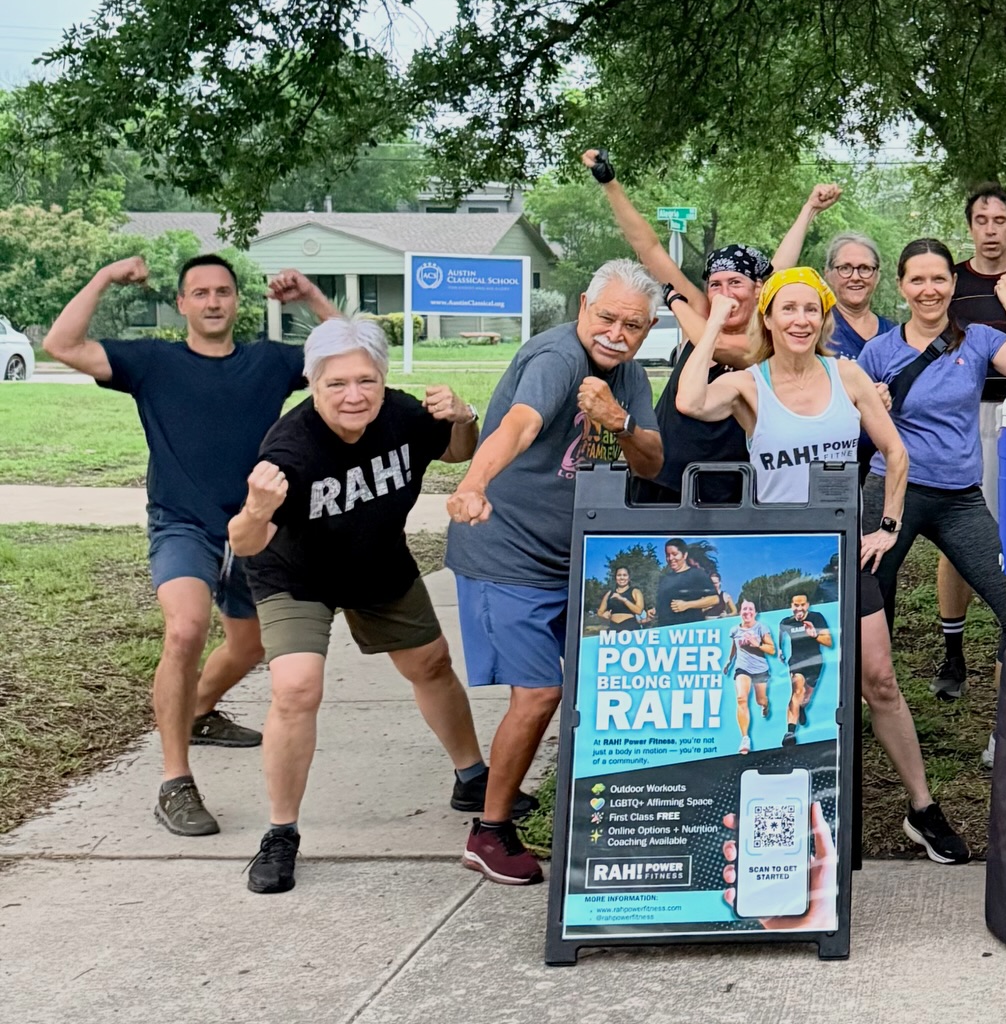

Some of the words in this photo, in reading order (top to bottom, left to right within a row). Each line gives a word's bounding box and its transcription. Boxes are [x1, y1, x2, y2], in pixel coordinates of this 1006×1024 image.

[447, 269, 476, 277] AUSTIN
[446, 276, 486, 284] CLASSICAL
[487, 277, 519, 285] SCHOOL
[760, 444, 819, 471] RAH!
[823, 438, 859, 453] POWE
[824, 450, 853, 460] FITNE
[308, 443, 412, 520] RAH!
[599, 629, 660, 645] MOVE
[669, 629, 721, 644] WITH
[597, 646, 723, 673] POWER
[597, 675, 671, 690] BELONG
[677, 675, 723, 688] WITH
[596, 689, 723, 731] RAH!
[615, 748, 633, 756] body
[643, 747, 667, 755] motion
[703, 746, 718, 754] part
[608, 757, 650, 765] community.
[610, 785, 644, 794] Outdoor
[646, 784, 686, 793] Workouts
[610, 798, 645, 808] LGBTQ+
[646, 798, 685, 808] Affirming
[686, 797, 713, 806] Space
[609, 813, 628, 822] First
[630, 812, 654, 821] Class
[656, 811, 681, 821] FREE
[608, 826, 636, 835] Online
[637, 825, 671, 835] Options
[681, 824, 718, 834] Nutrition
[607, 837, 647, 848] Coaching
[648, 836, 688, 845] Available
[593, 863, 643, 881] RAH!
[645, 862, 684, 872] POWER
[596, 905, 682, 913] www.rahpowerfitness.com
